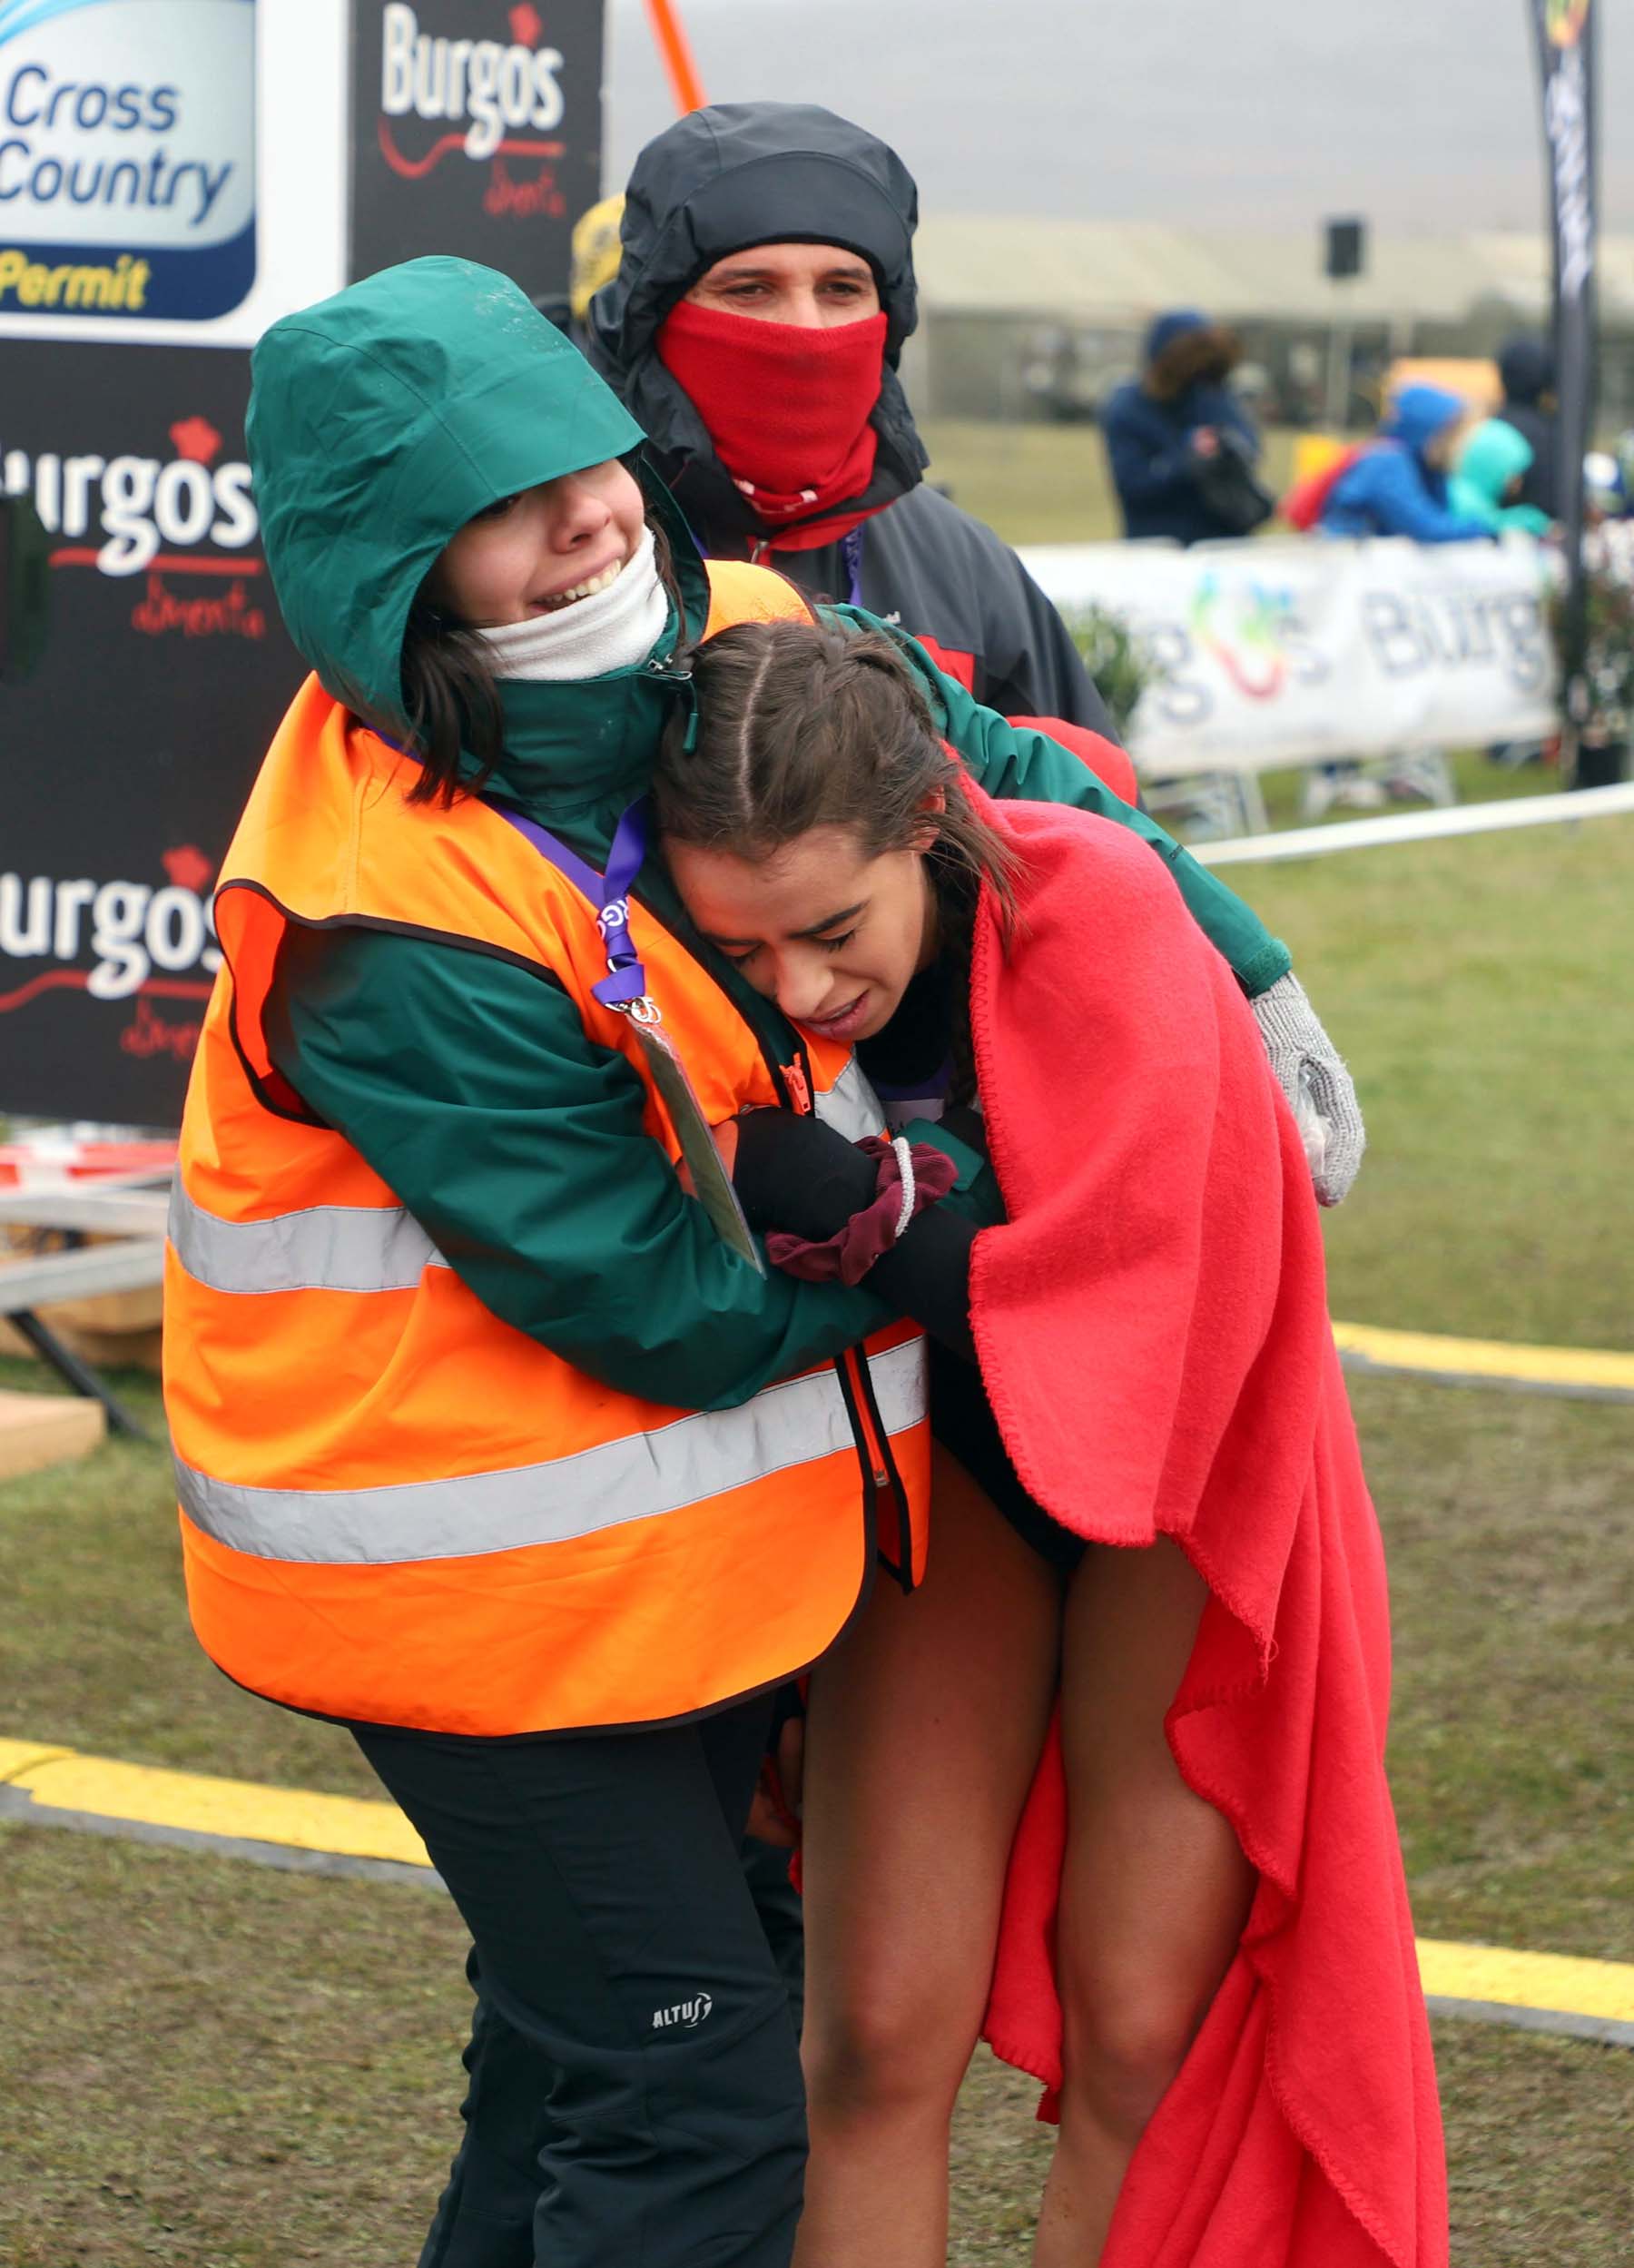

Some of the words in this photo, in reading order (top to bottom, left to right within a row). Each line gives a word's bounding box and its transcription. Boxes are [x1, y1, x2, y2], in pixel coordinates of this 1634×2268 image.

[6, 64, 180, 133] Cross
[381, 3, 565, 160] Burgos
[0, 139, 232, 225] Country
[0, 249, 151, 311] Permit
[0, 447, 260, 577] urgos
[652, 1996, 704, 2029] ALTUS
